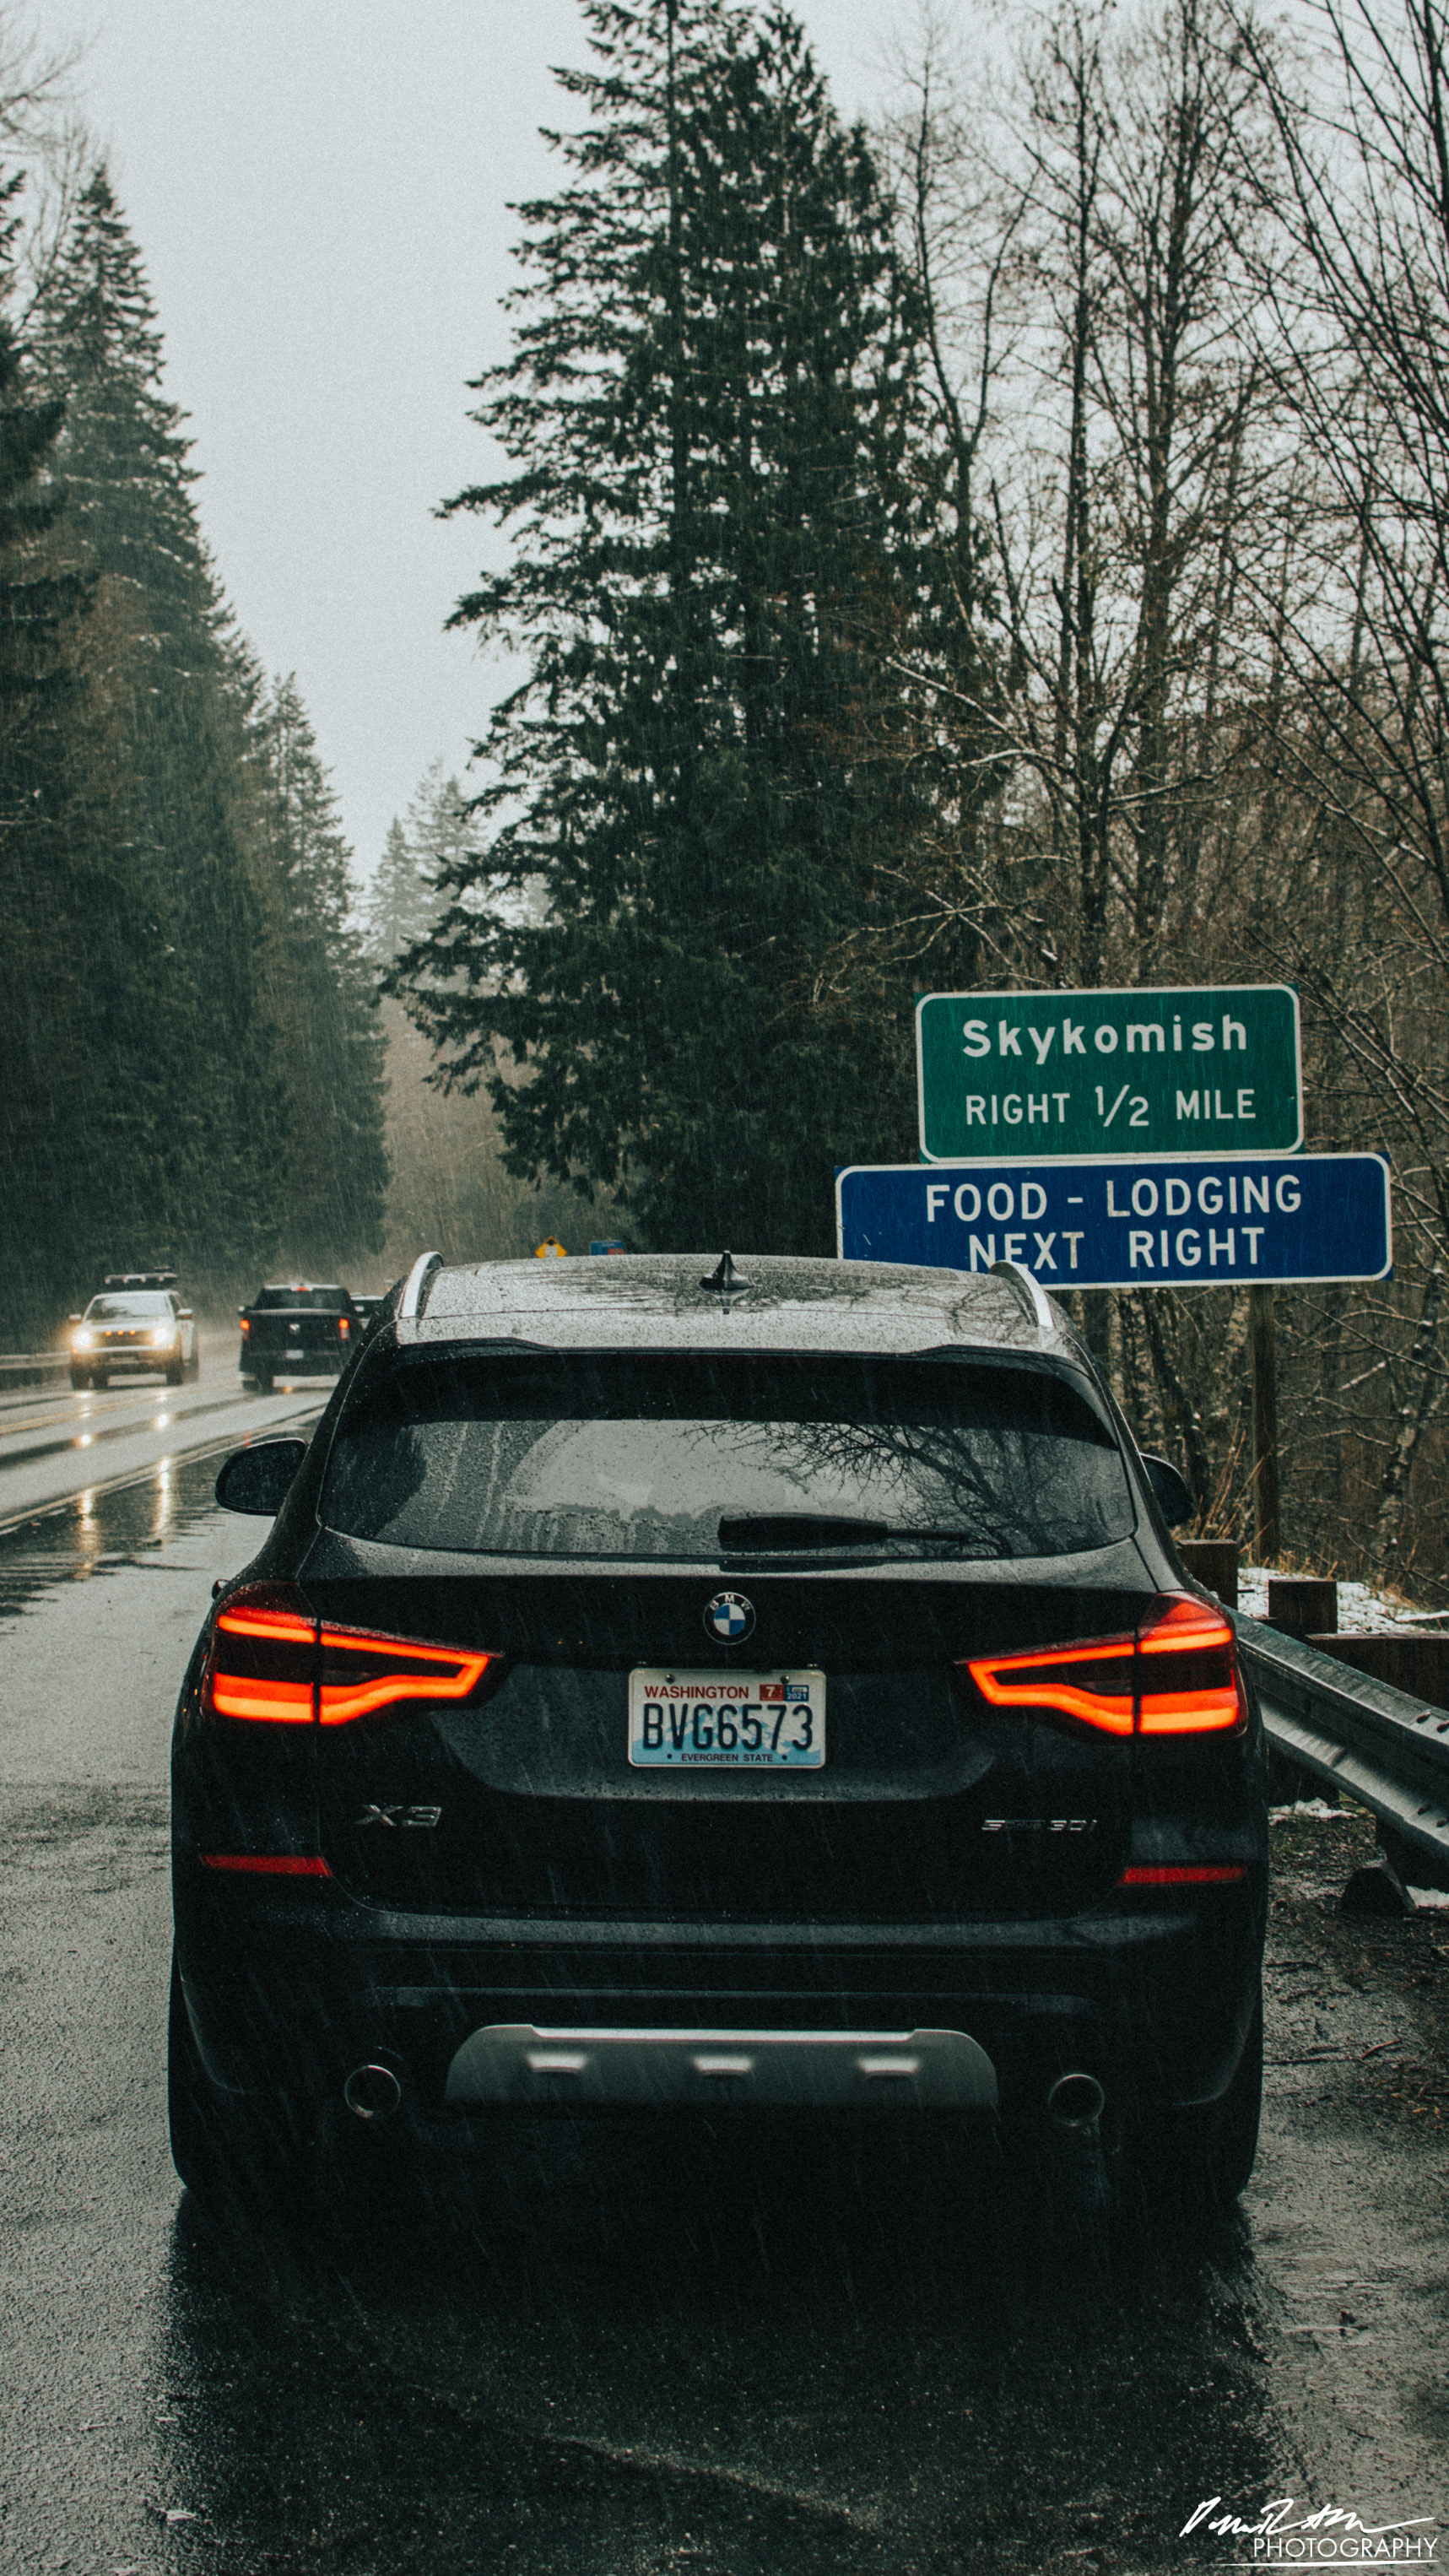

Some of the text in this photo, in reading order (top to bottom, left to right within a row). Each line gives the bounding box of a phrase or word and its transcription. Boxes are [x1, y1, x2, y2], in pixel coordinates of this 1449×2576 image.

[961, 1015, 1248, 1065] Skykomish
[965, 1085, 1256, 1127] RIGHT 1/2 MILE
[926, 1182, 1048, 1222] FOOD
[1106, 1175, 1301, 1217] LODGING
[969, 1226, 1265, 1272] NEXT RIGHT
[709, 1594, 751, 1612] BMW
[644, 1686, 808, 1701] WASHINGTON 7 2021
[642, 1702, 814, 1751] BVG6573
[681, 1753, 774, 1762] EVERGREEN STATE
[354, 1805, 442, 1826] X3
